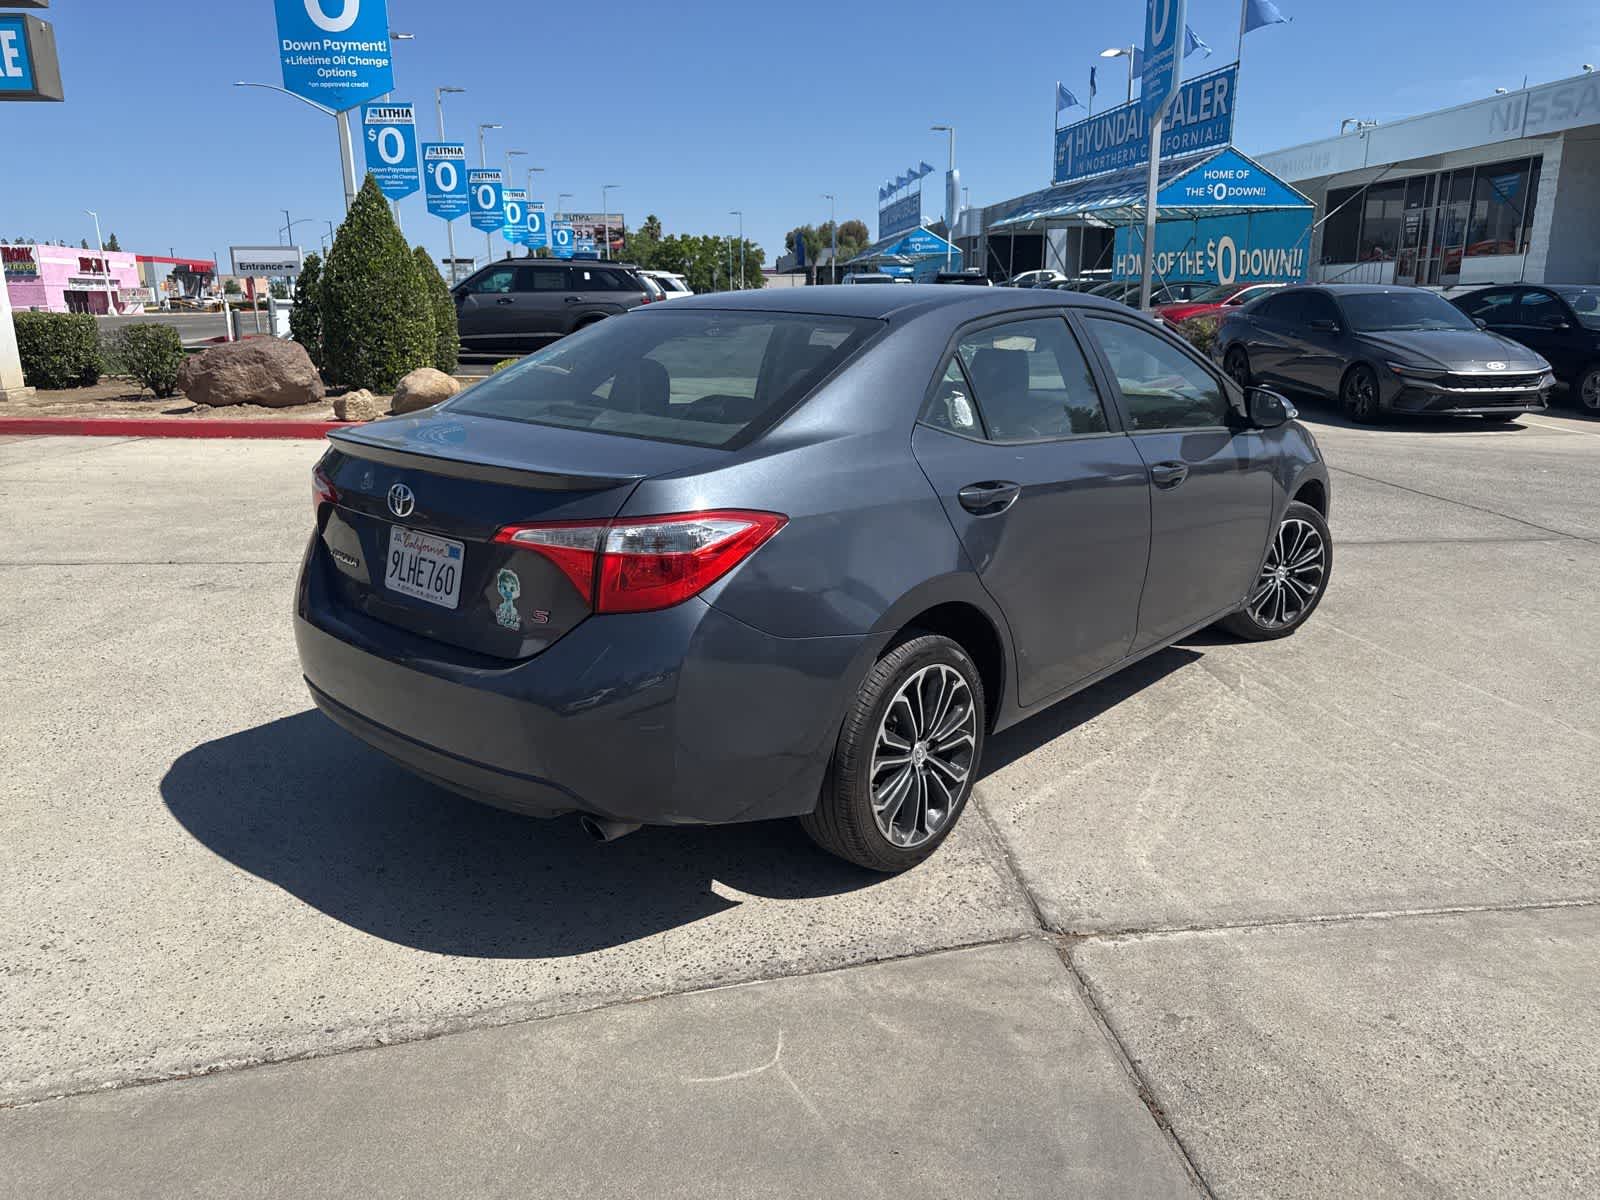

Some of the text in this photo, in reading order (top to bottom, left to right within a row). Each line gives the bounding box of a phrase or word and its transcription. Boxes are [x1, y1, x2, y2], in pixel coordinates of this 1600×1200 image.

[283, 40, 387, 53] Down Payment!
[285, 56, 389, 67] +Lifetime Oil Change
[317, 68, 357, 78] Options
[379, 109, 412, 118] LITHIA
[1075, 108, 1143, 157] HYUNDAI
[1148, 77, 1228, 134] EALER
[1087, 147, 1136, 170] NORTHERN
[1141, 123, 1224, 158] CIFORNIA!!
[1204, 170, 1250, 179] HOME OF
[1186, 187, 1205, 196] THE
[1228, 187, 1266, 196] DOWN!!
[239, 263, 283, 271] Entrance
[1177, 250, 1204, 274] THE
[1239, 248, 1303, 277] DOWN!!
[389, 550, 456, 596] 9LHE760
[531, 609, 550, 624] S
